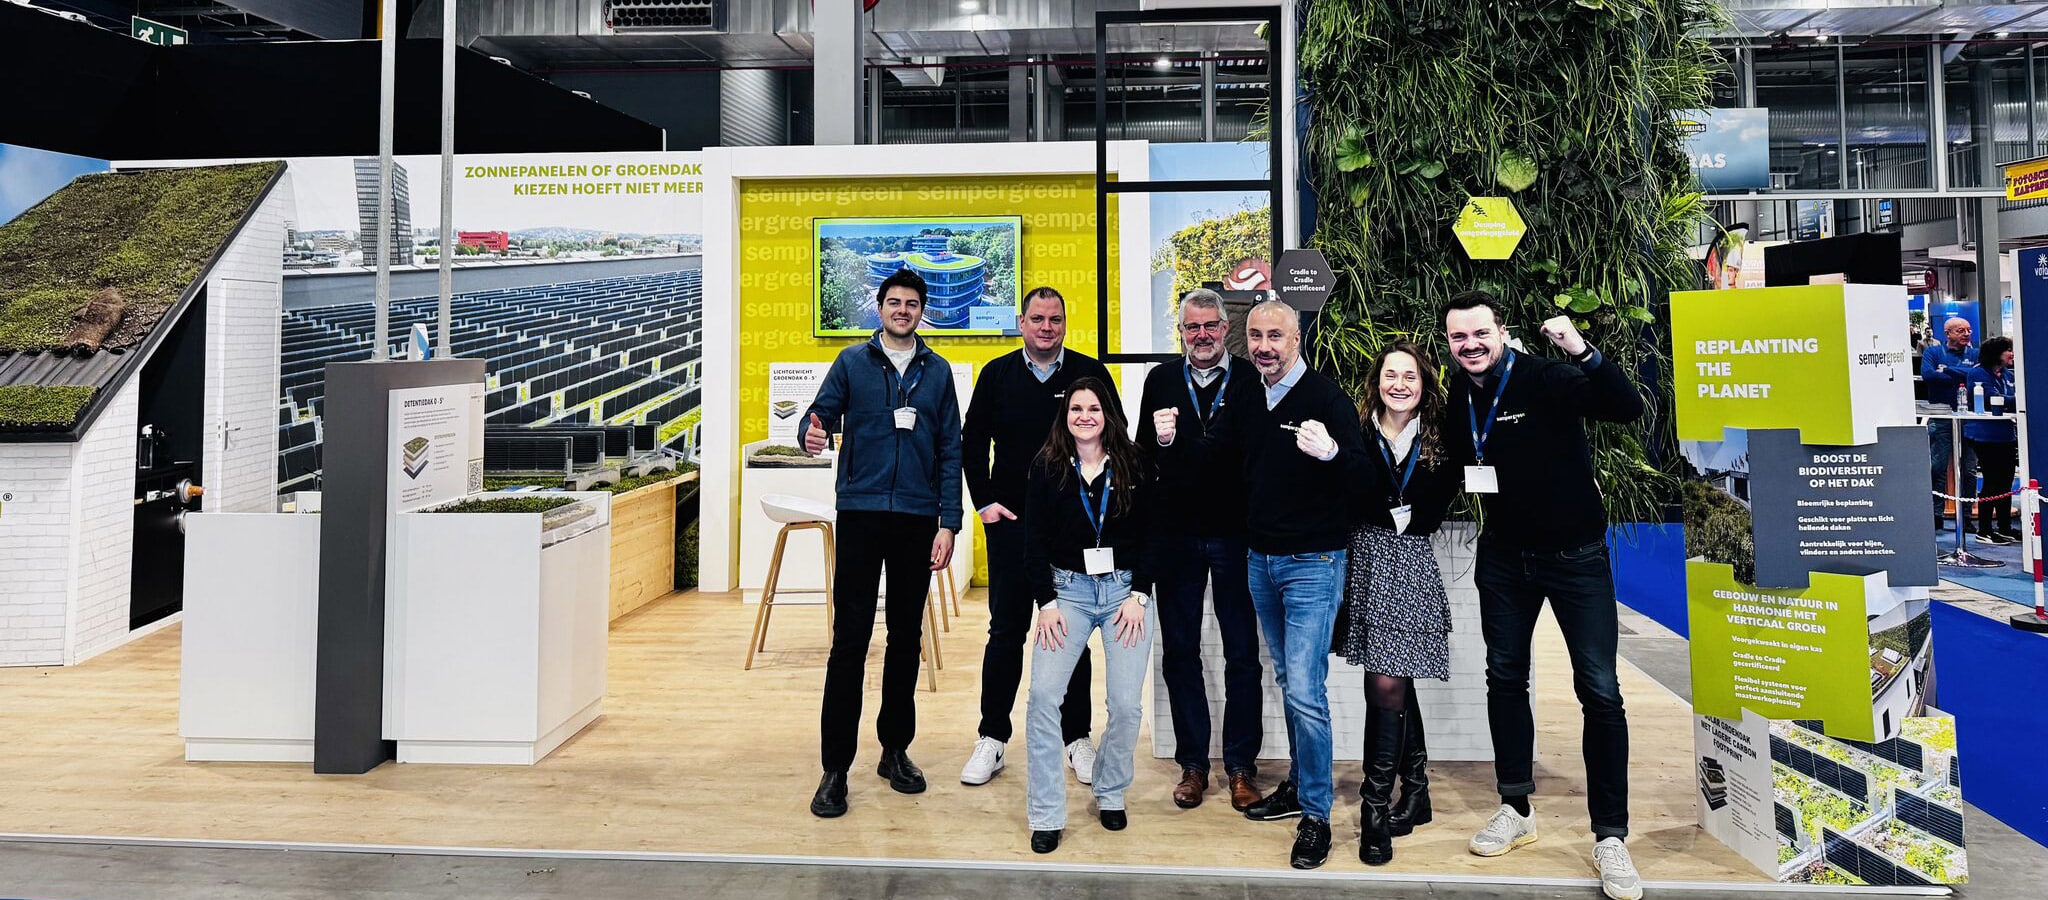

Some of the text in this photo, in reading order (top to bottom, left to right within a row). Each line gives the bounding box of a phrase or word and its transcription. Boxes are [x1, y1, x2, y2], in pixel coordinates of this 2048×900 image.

[465, 163, 703, 178] ZONNEPANELEN OF GROENDAK
[513, 181, 703, 195] KIEZEN HOEFT NIET MEER
[1695, 338, 1819, 355] REPLANTING
[1858, 351, 1905, 367] sempergreen
[1696, 362, 1731, 376] THE
[1698, 384, 1771, 398] PLANET
[404, 399, 433, 408] DETENTIEDAK
[1813, 454, 1868, 463] BOOST DE
[1798, 466, 1884, 476] BIODIVERSITEIT
[1809, 478, 1874, 488] OP HET DAK
[1835, 499, 1873, 507] beplanting
[1800, 540, 1846, 548] Aantrekkelijk
[1864, 540, 1884, 548] bijen,
[1713, 589, 1838, 610] GEBOUW EN NATUUR IN
[1733, 603, 1817, 620] HARMONIE MET
[1726, 614, 1826, 634] VERTICAAL GROEN
[1781, 641, 1789, 649] in
[1789, 643, 1809, 652] eigen
[1810, 645, 1822, 653] kas
[1732, 651, 1754, 660] Cradle
[1764, 655, 1786, 664] Cradle
[1733, 660, 1780, 672] gecertificeerd
[1734, 675, 1807, 692] Flexibel systeem voor
[1734, 683, 1759, 693] perfect
[1721, 722, 1751, 745] GROENDAK
[1711, 724, 1732, 747] LAGERE
[1732, 739, 1757, 760] CARBON
[1713, 738, 1743, 762] FOOTPRINT
